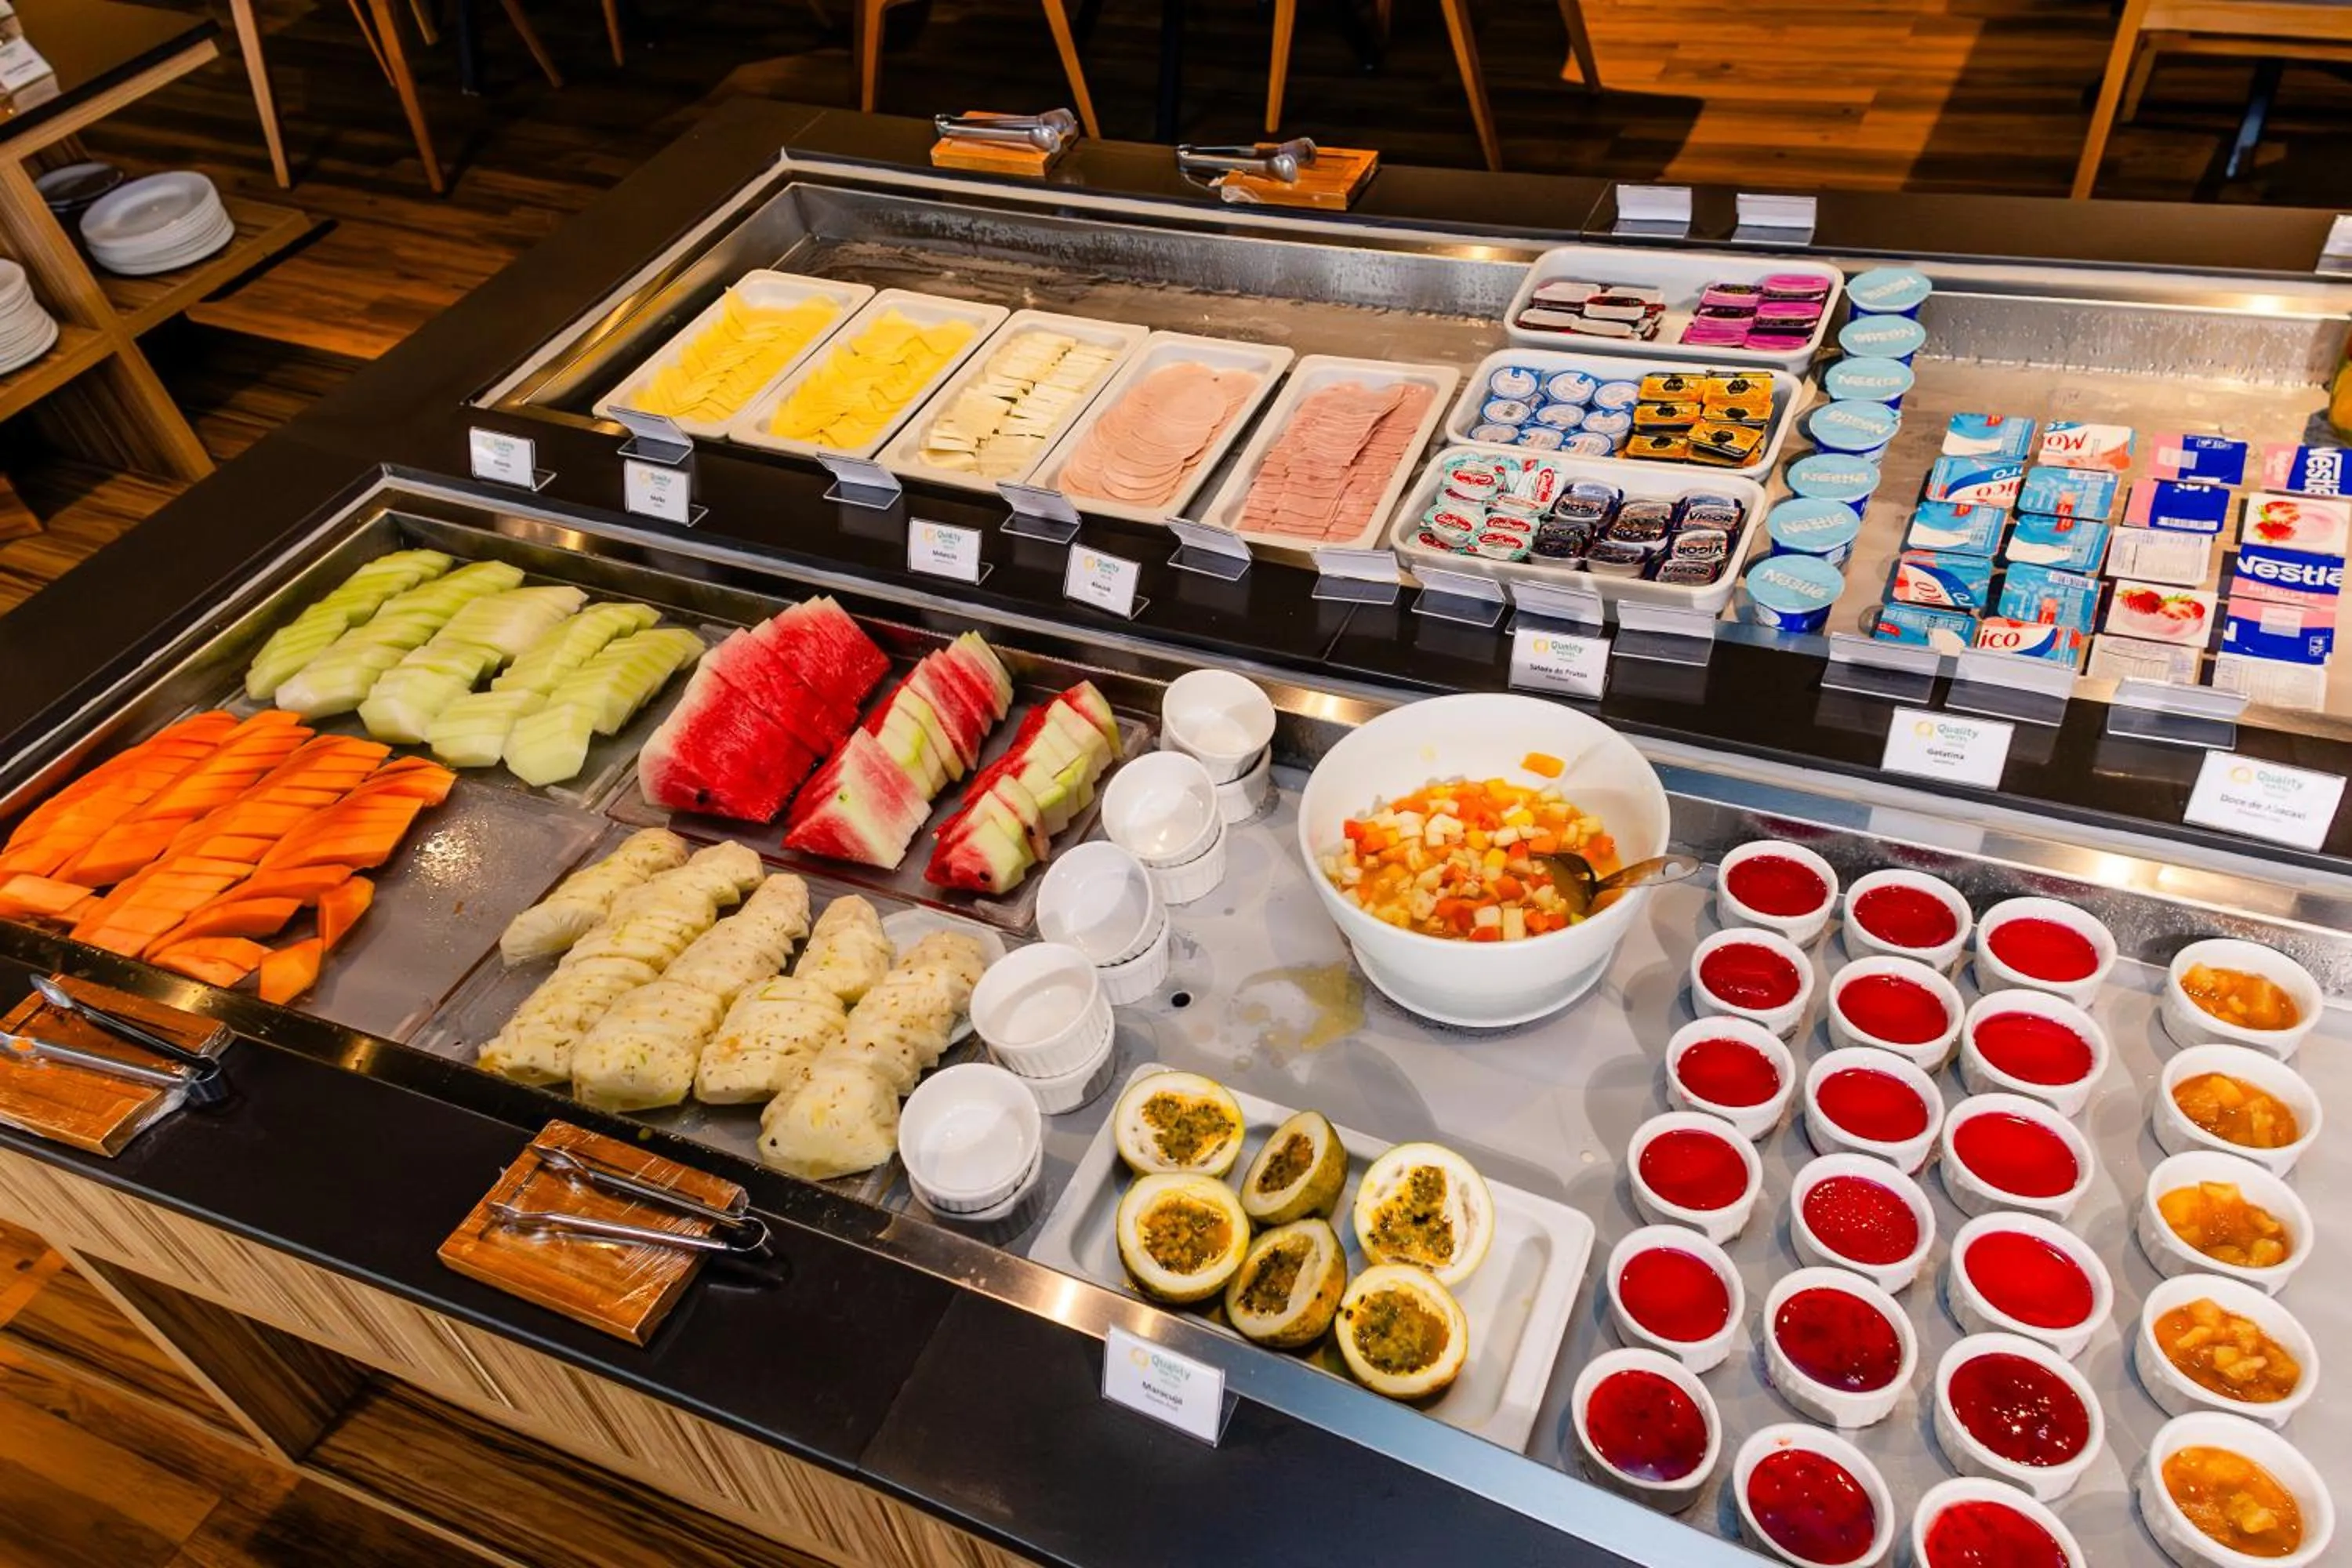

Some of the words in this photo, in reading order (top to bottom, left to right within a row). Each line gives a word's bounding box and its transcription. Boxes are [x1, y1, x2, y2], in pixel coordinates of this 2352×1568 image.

[1677, 544, 1723, 555] VIGOR
[1551, 641, 1584, 654] Quality
[1565, 670, 1588, 679] Frutas
[1937, 724, 1980, 739] Quality
[1926, 748, 1965, 760] Gelatina
[2257, 770, 2305, 790] Quality
[2220, 793, 2246, 806] Doce
[2248, 800, 2263, 810] de
[1151, 1353, 1191, 1381] Quality
